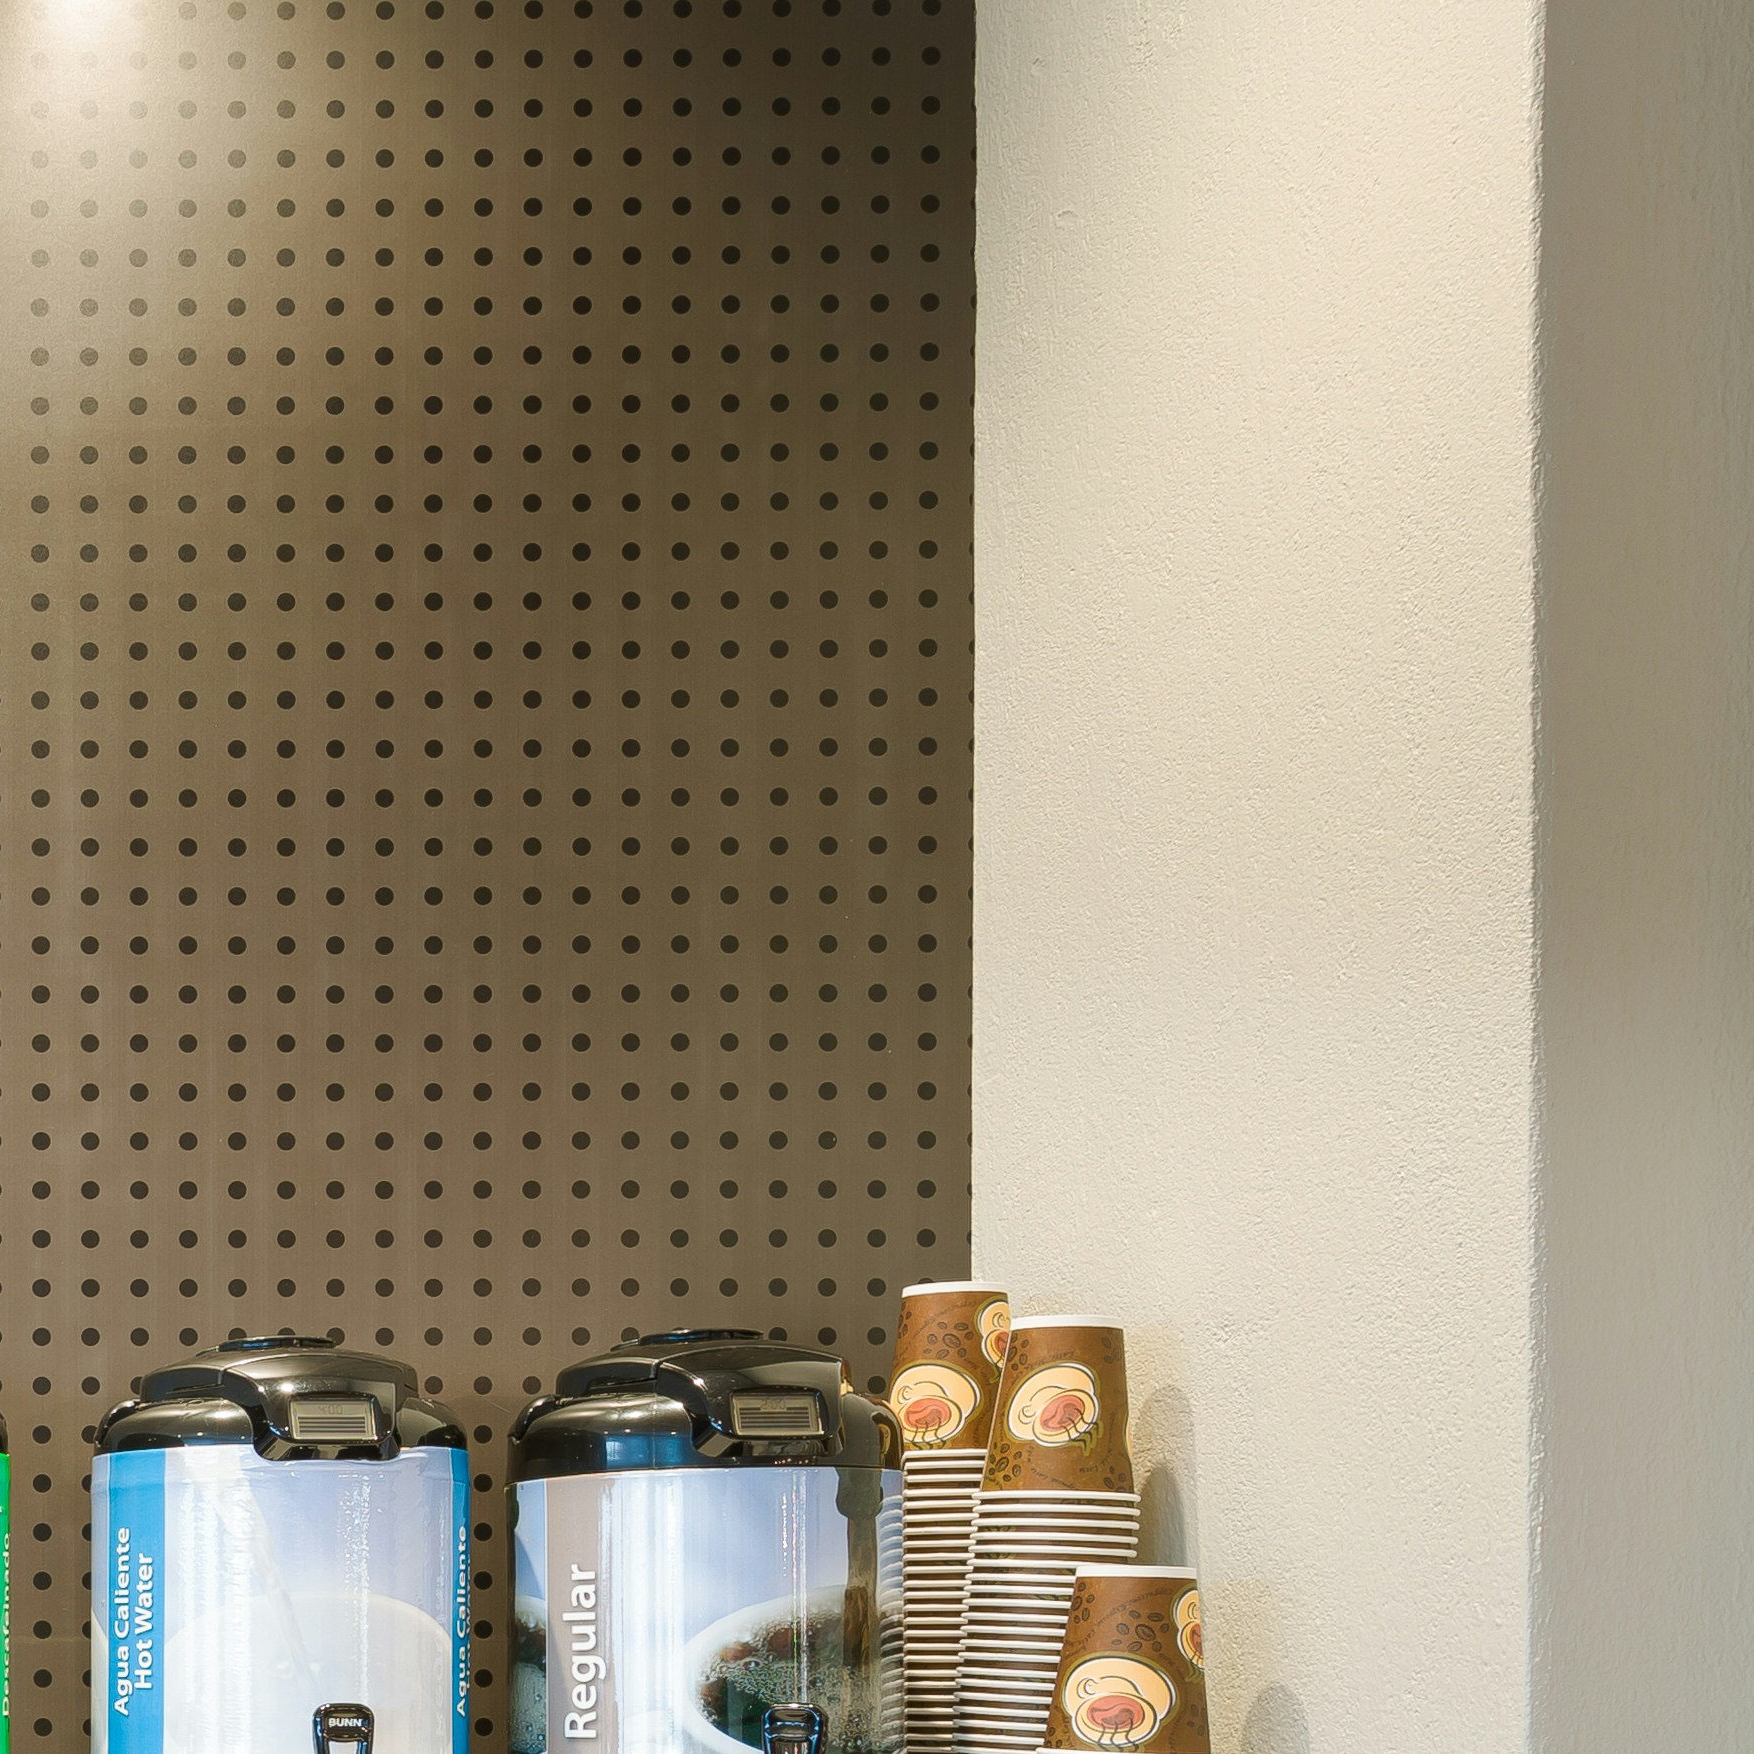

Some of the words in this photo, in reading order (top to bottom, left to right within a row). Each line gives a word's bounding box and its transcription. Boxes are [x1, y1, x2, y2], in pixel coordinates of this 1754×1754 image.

[114, 1527, 131, 1640] Caliente
[134, 1552, 153, 1636] Water
[456, 1526, 467, 1639] Caliente
[114, 1646, 133, 1716] Agua
[134, 1639, 153, 1690] Hot
[456, 1646, 467, 1717] Agua
[562, 1563, 606, 1739] Regular
[328, 1718, 363, 1727] BUNN
